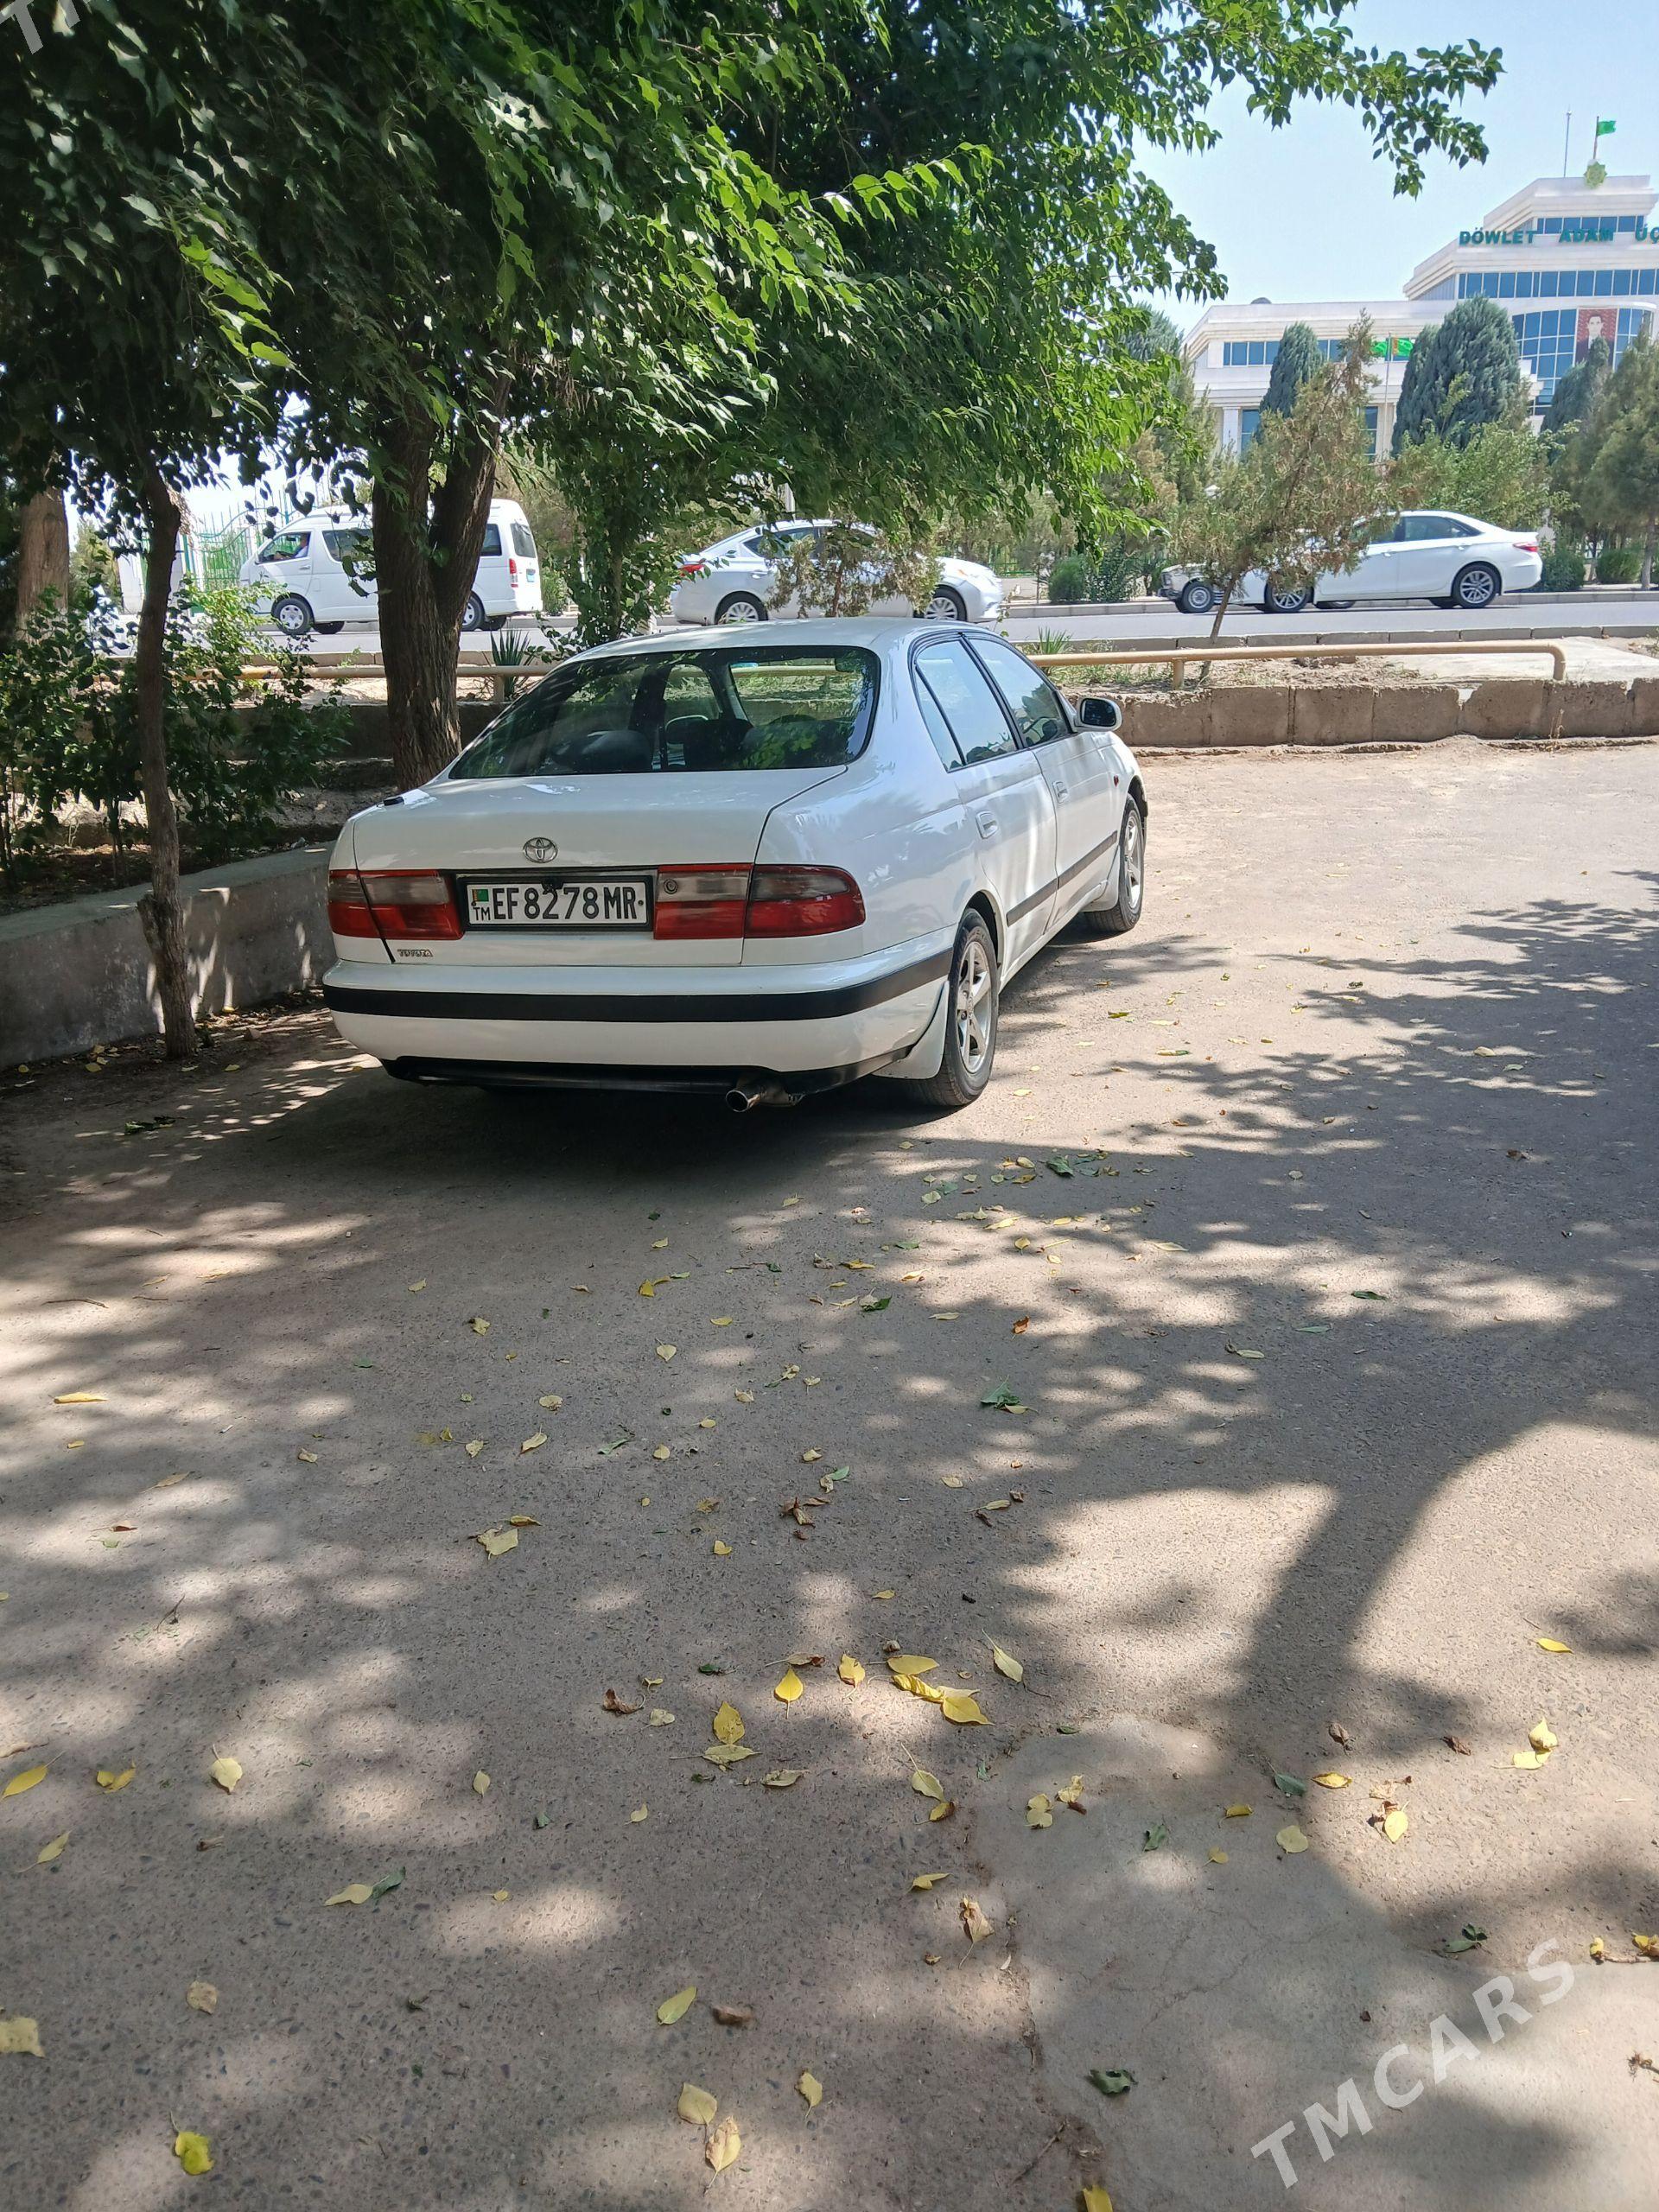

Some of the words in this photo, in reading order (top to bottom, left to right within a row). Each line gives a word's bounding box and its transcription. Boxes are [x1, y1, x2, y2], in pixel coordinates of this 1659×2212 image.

[1459, 226, 1537, 245] DÖWLET
[1559, 228, 1614, 243] ADAM
[492, 887, 637, 919] EF8278MR
[473, 906, 491, 921] TM
